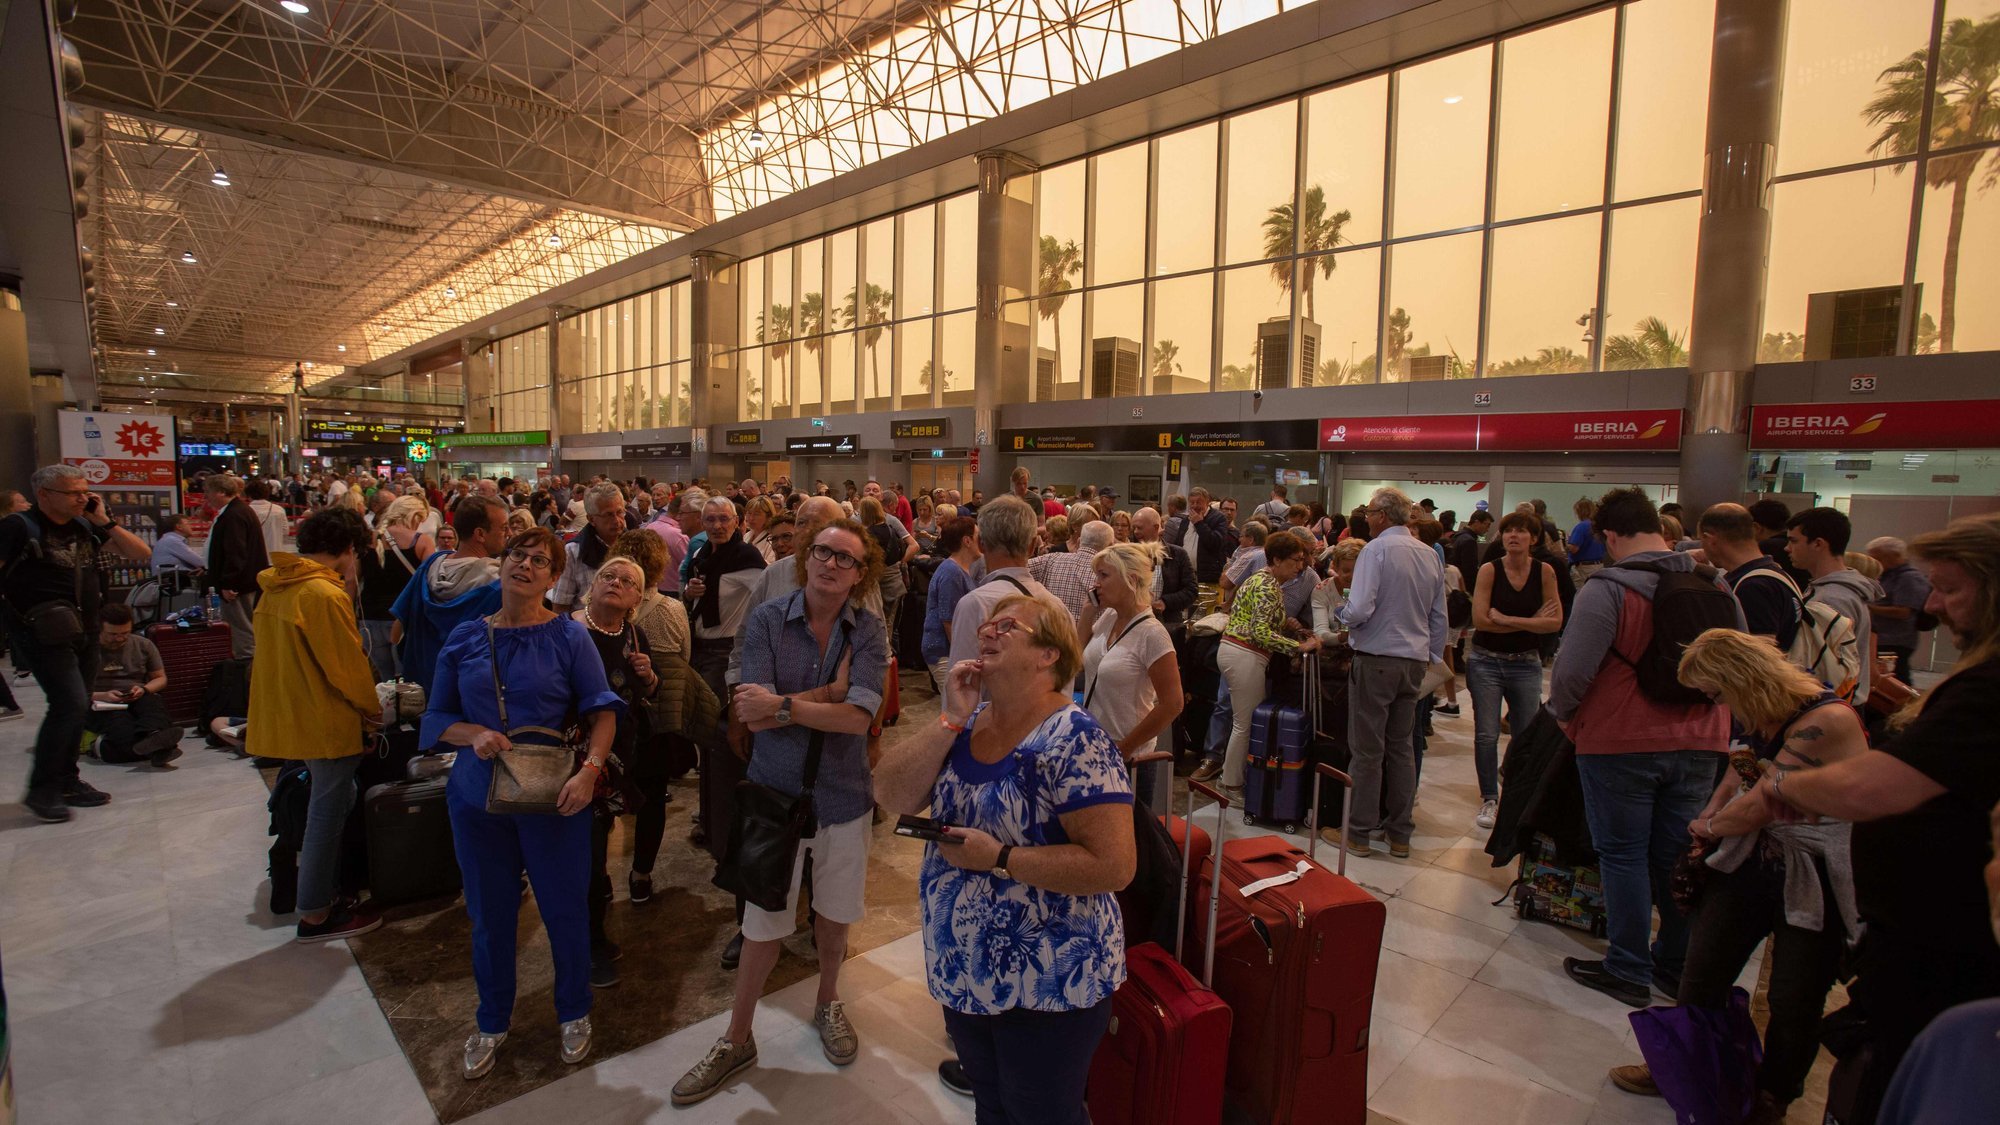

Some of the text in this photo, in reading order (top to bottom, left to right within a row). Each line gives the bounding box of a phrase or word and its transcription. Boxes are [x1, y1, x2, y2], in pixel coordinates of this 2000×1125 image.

[1852, 378, 1875, 390] 33
[1475, 394, 1490, 404] 34
[1133, 408, 1143, 416] 35
[1766, 415, 1850, 428] IBERIA
[1574, 421, 1638, 433] IBERIA
[127, 429, 153, 447] 1€
[1036, 441, 1095, 449] Información Aeropuerto
[1189, 439, 1265, 448] Información Aeropuerto
[87, 470, 104, 479] 1€
